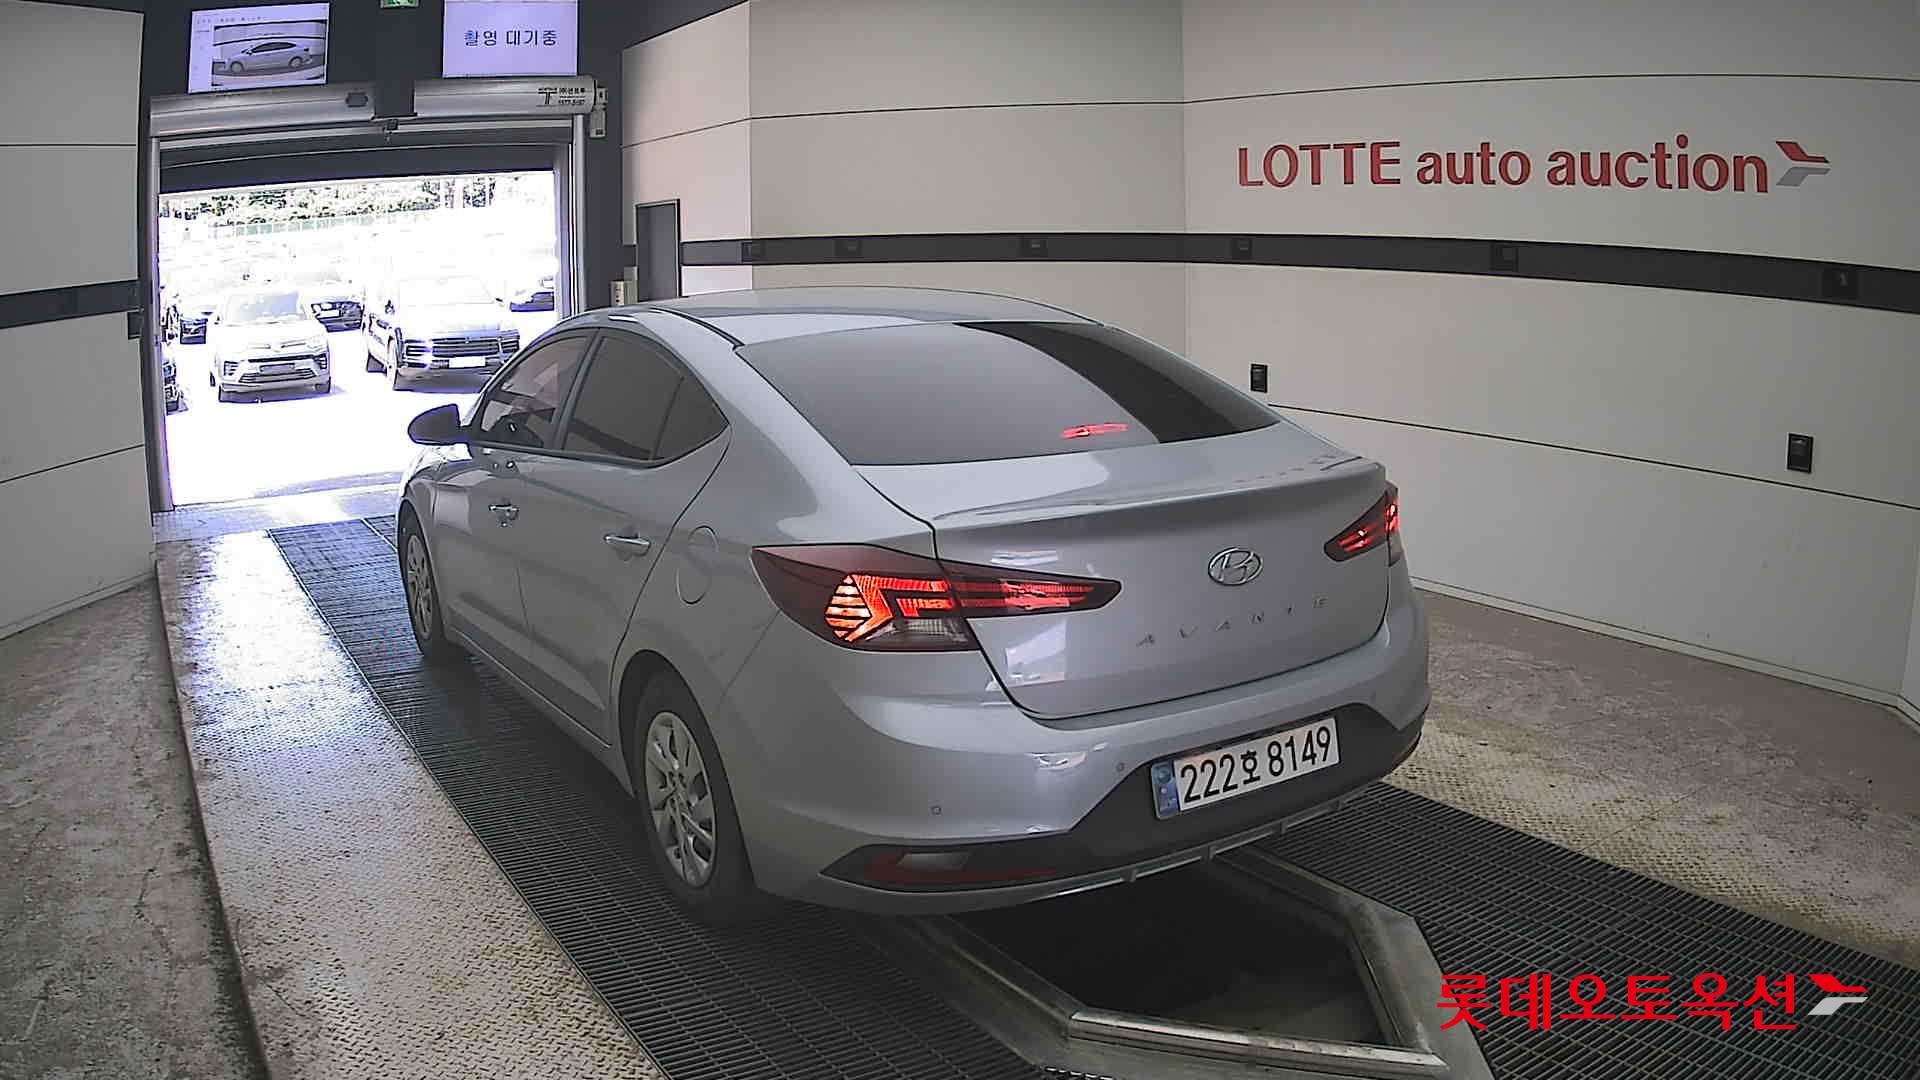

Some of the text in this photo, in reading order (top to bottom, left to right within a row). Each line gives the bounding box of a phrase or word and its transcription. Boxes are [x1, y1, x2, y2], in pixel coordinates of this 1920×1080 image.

[464, 29, 557, 47] 촬영 대기중
[1239, 135, 1769, 193] LOTTE auto auction
[1136, 597, 1328, 647] AVANTE
[1180, 726, 1331, 804] 222호 8149
